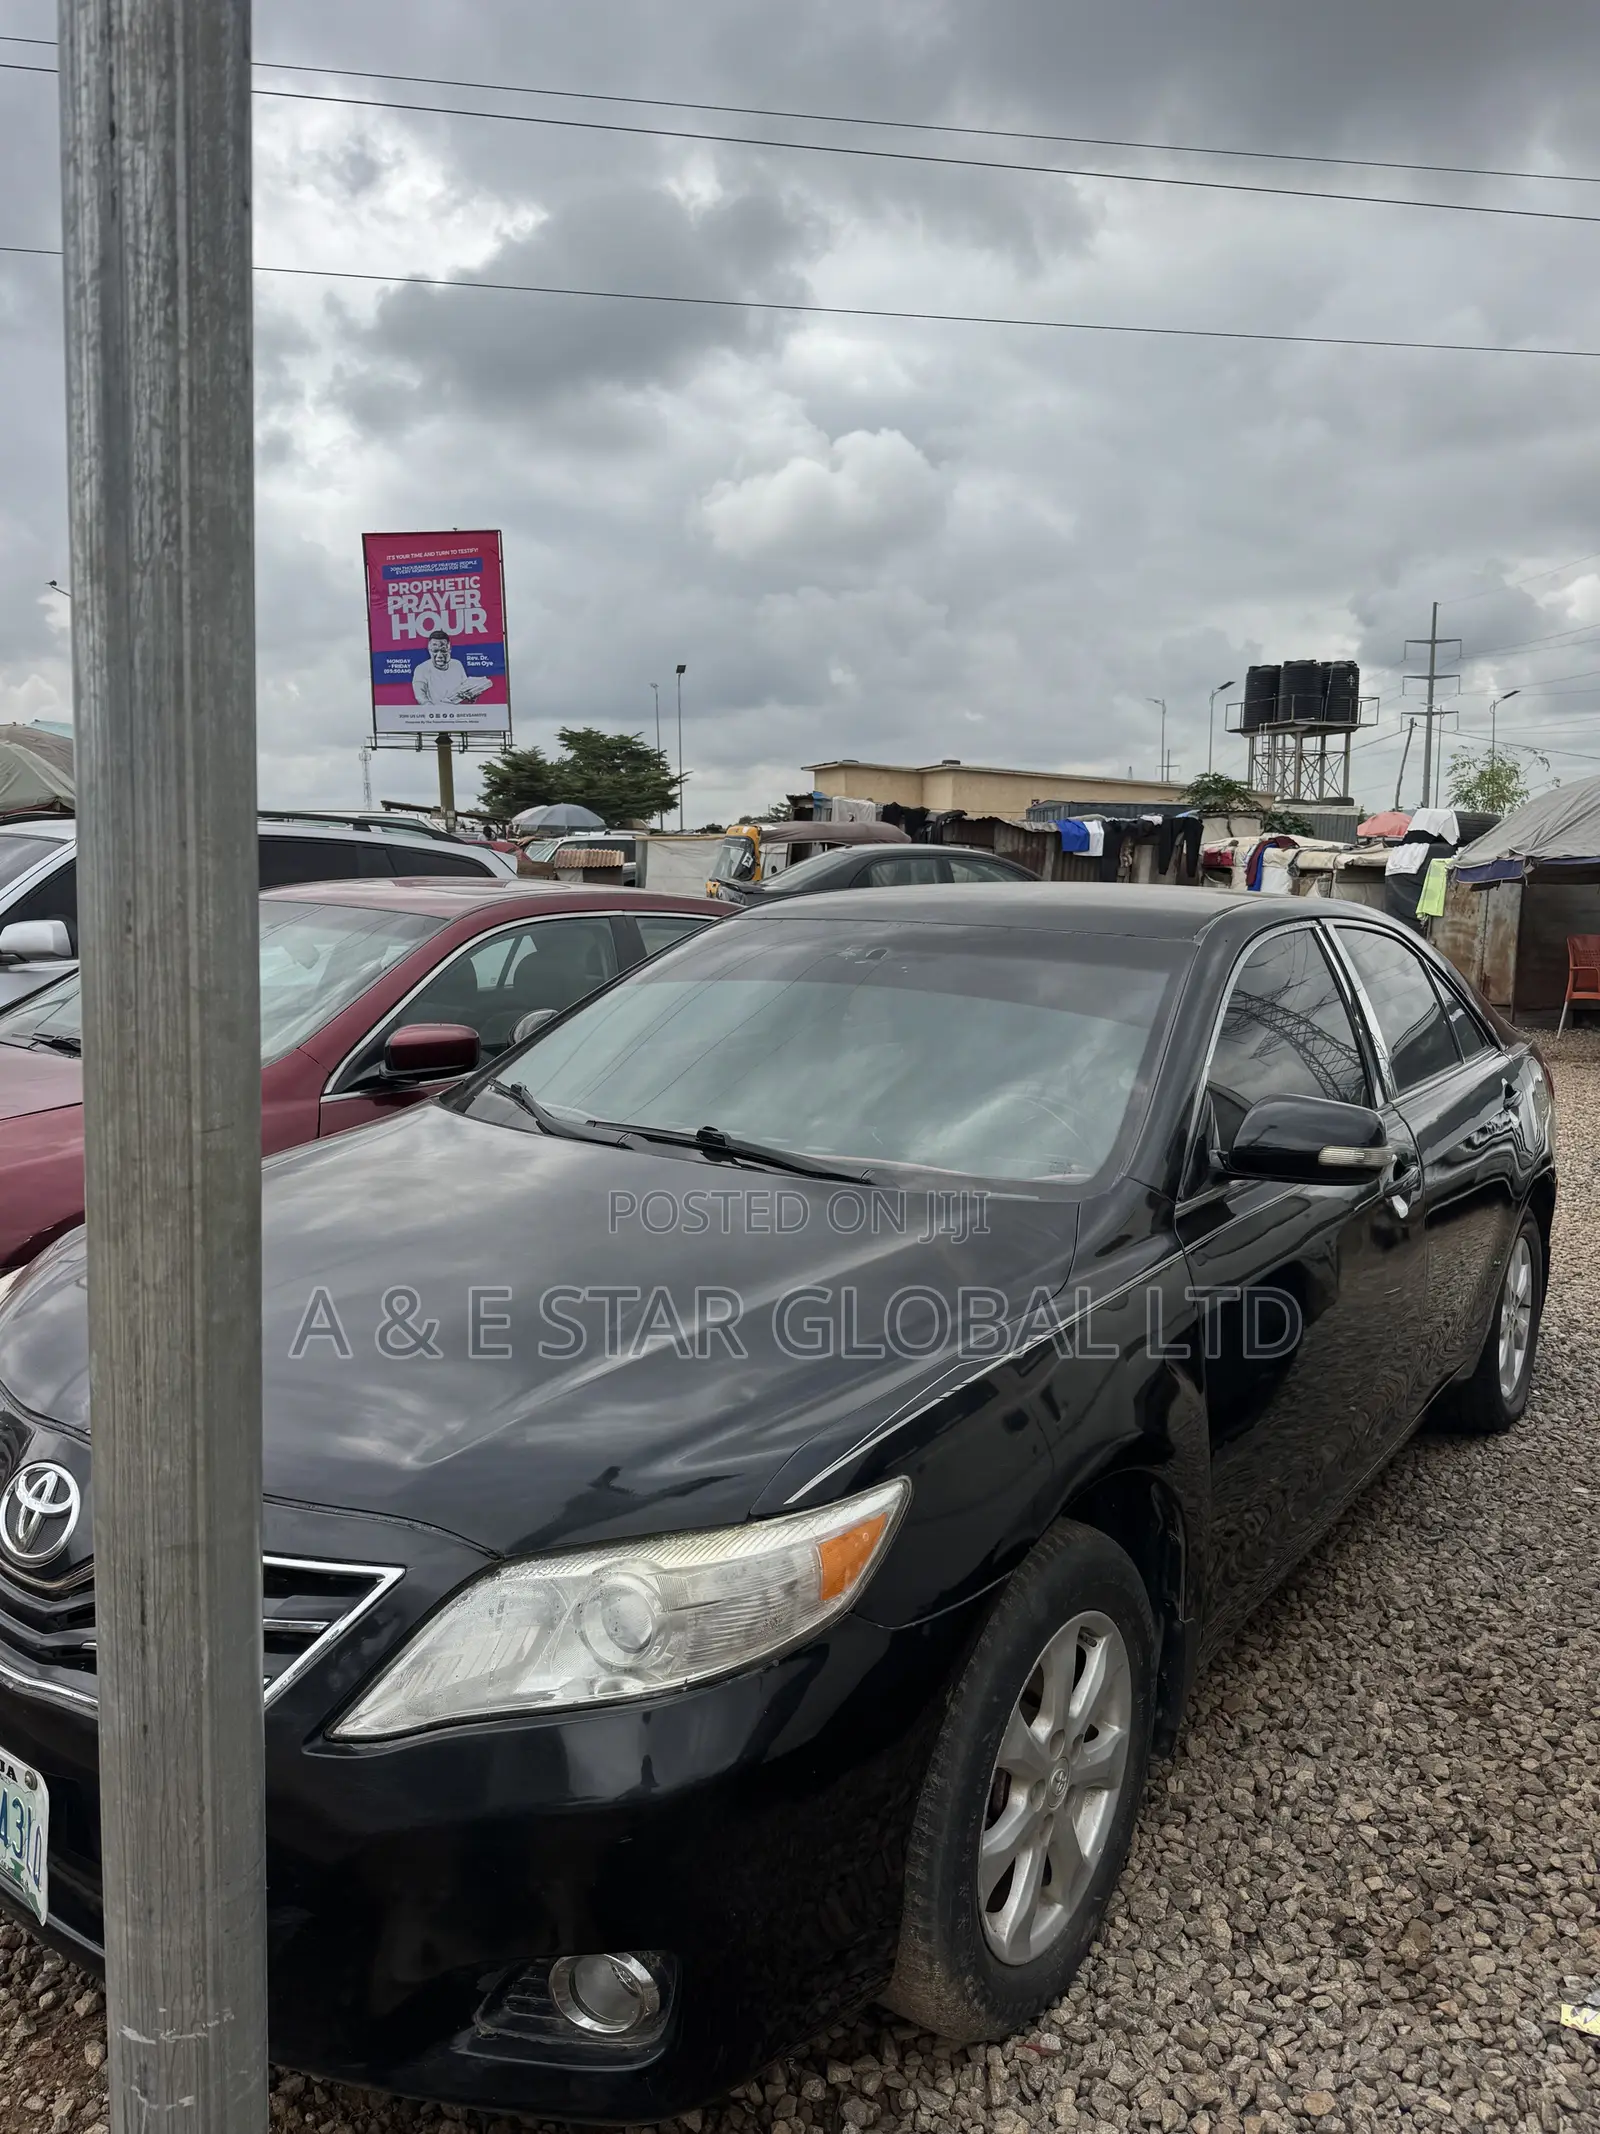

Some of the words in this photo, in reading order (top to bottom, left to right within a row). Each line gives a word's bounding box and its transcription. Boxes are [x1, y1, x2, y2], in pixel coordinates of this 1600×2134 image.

[388, 576, 480, 596] PROPHETIC
[388, 589, 481, 615] PRAYER
[391, 608, 488, 640] HOUR
